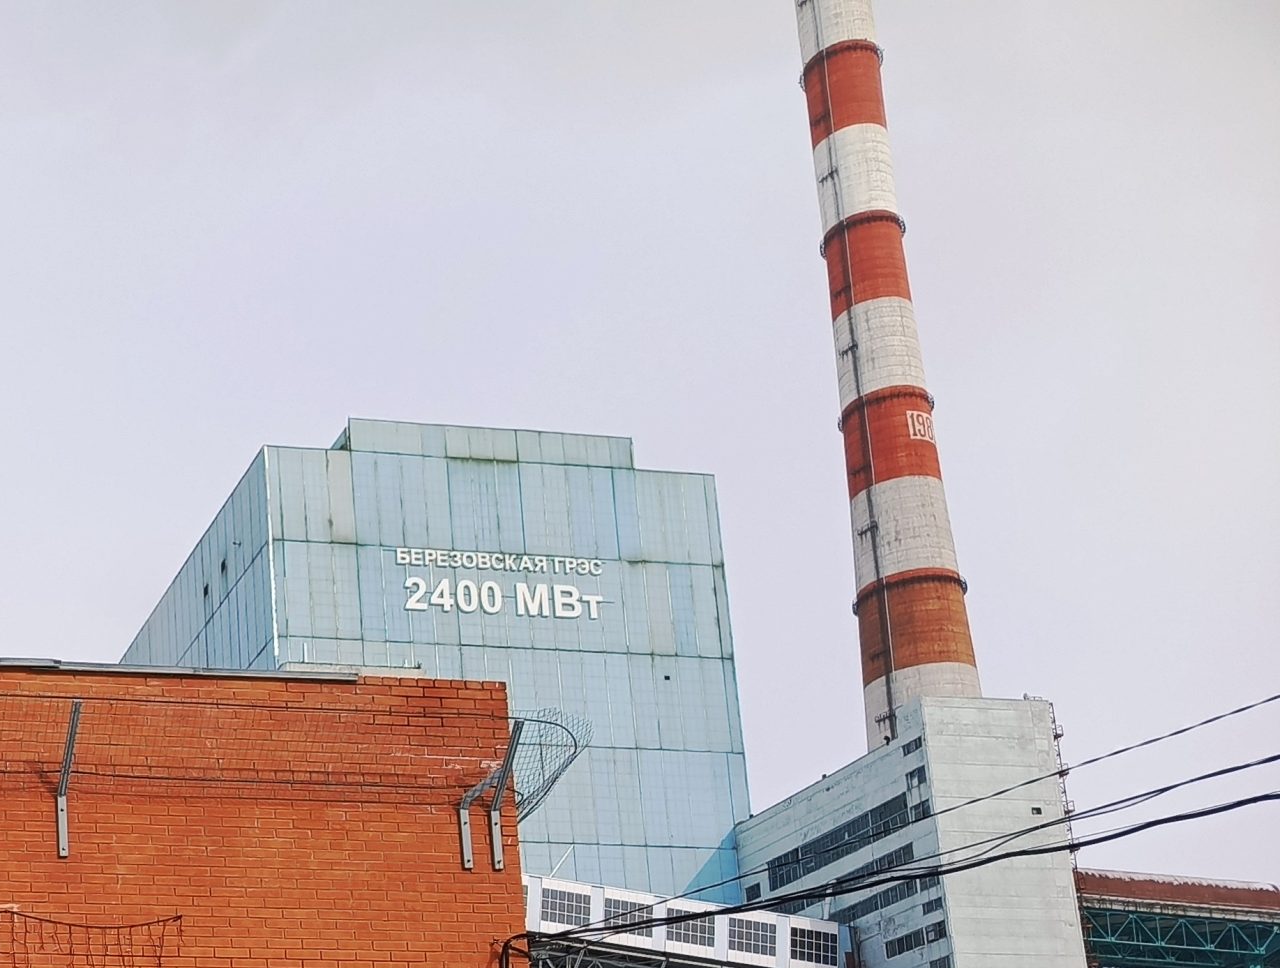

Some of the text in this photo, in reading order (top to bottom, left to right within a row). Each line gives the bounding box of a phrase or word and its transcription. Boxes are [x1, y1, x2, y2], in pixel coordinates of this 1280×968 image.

[909, 412, 935, 441] 198
[396, 548, 603, 576] БЕРЕЗОВСКАЯ ГРЭС
[404, 577, 603, 619] 2400 МВт
